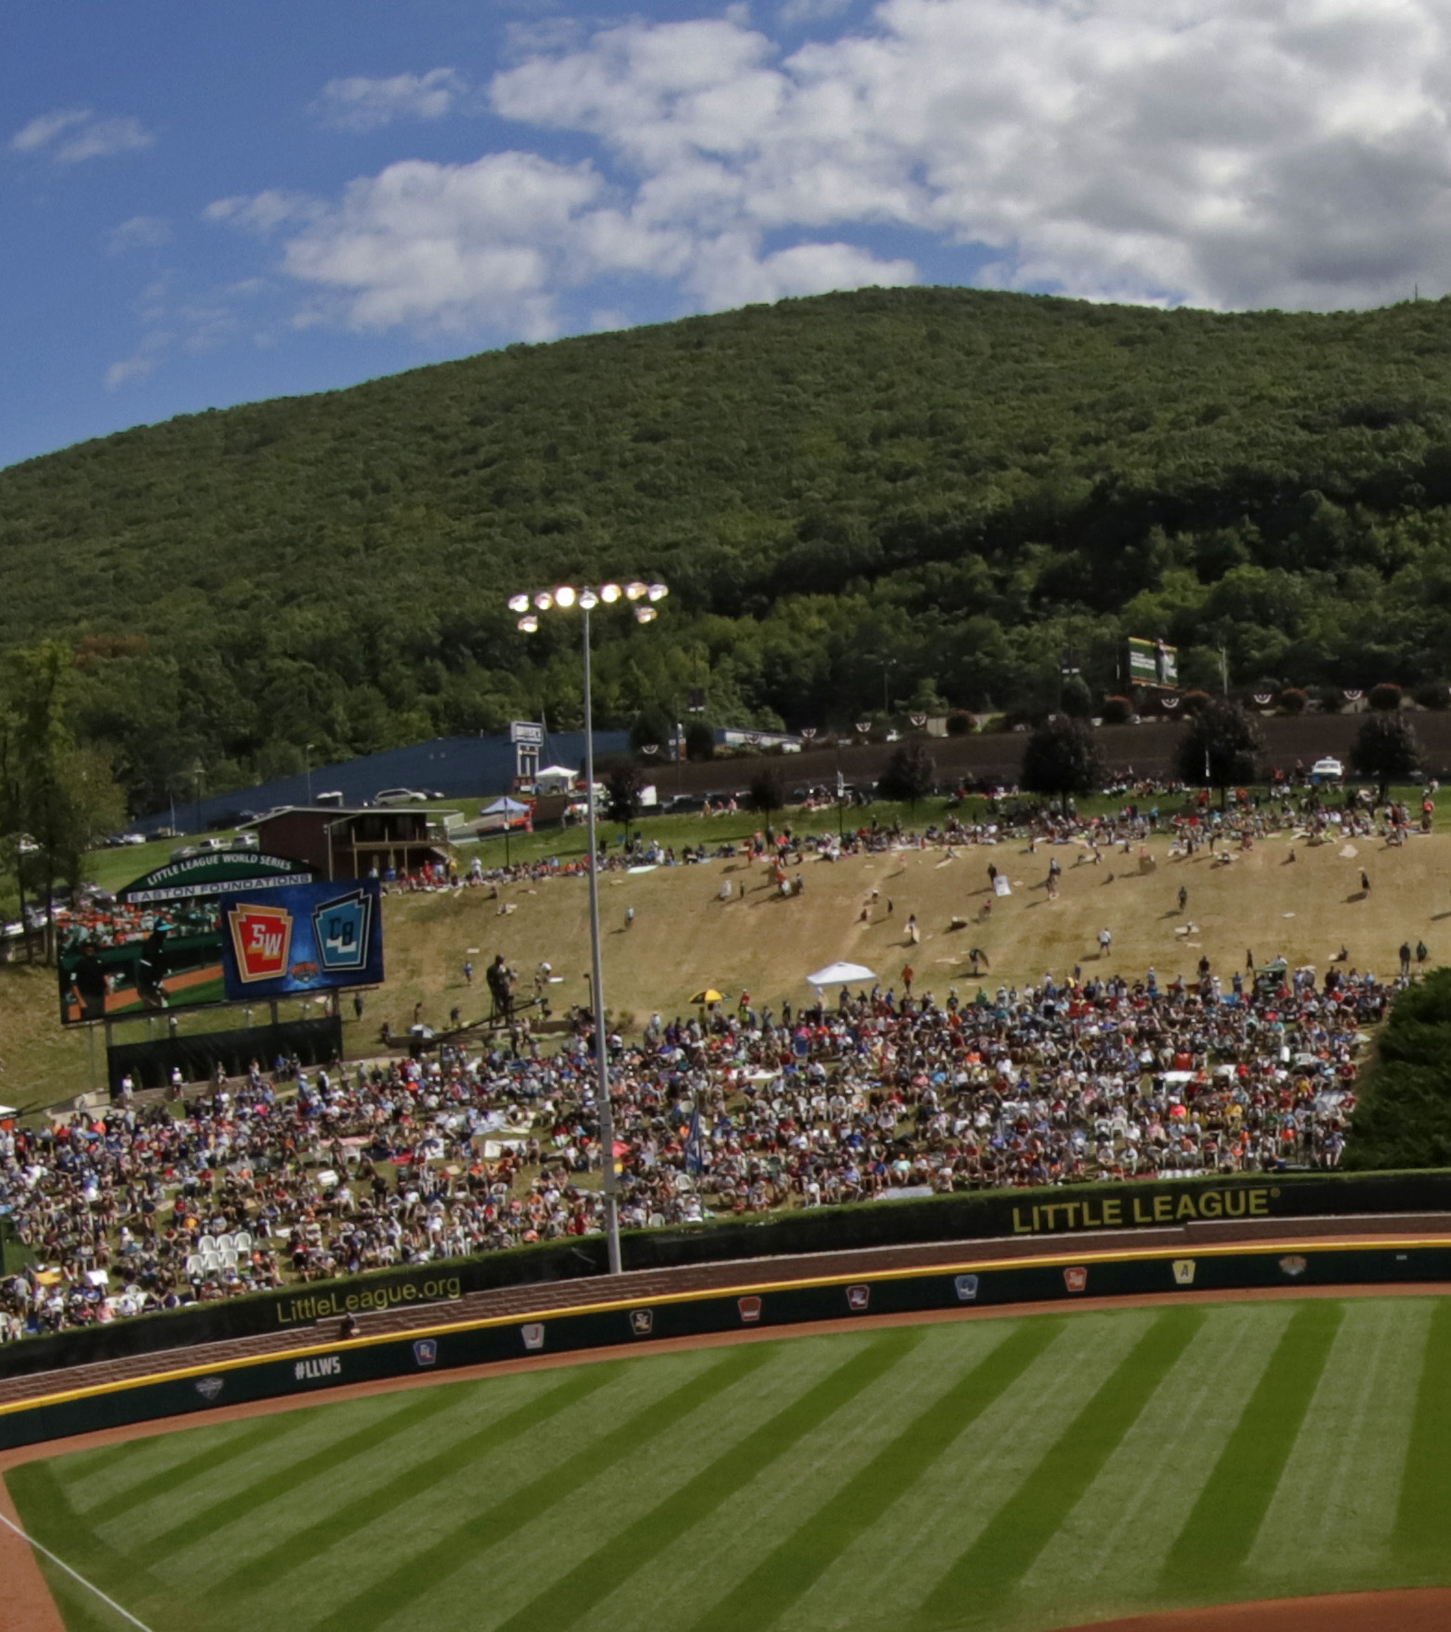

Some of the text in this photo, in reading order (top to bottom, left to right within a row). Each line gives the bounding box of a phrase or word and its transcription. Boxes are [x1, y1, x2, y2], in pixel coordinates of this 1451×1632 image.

[147, 854, 292, 886] LITTLE LEAGUE WORLD SERIES
[131, 873, 310, 902] EASTON FOUNDATIONS
[1013, 1199, 1122, 1233] LITTLE
[276, 1277, 460, 1323] LittleLeague.org
[295, 1356, 341, 1380] #LLWS
